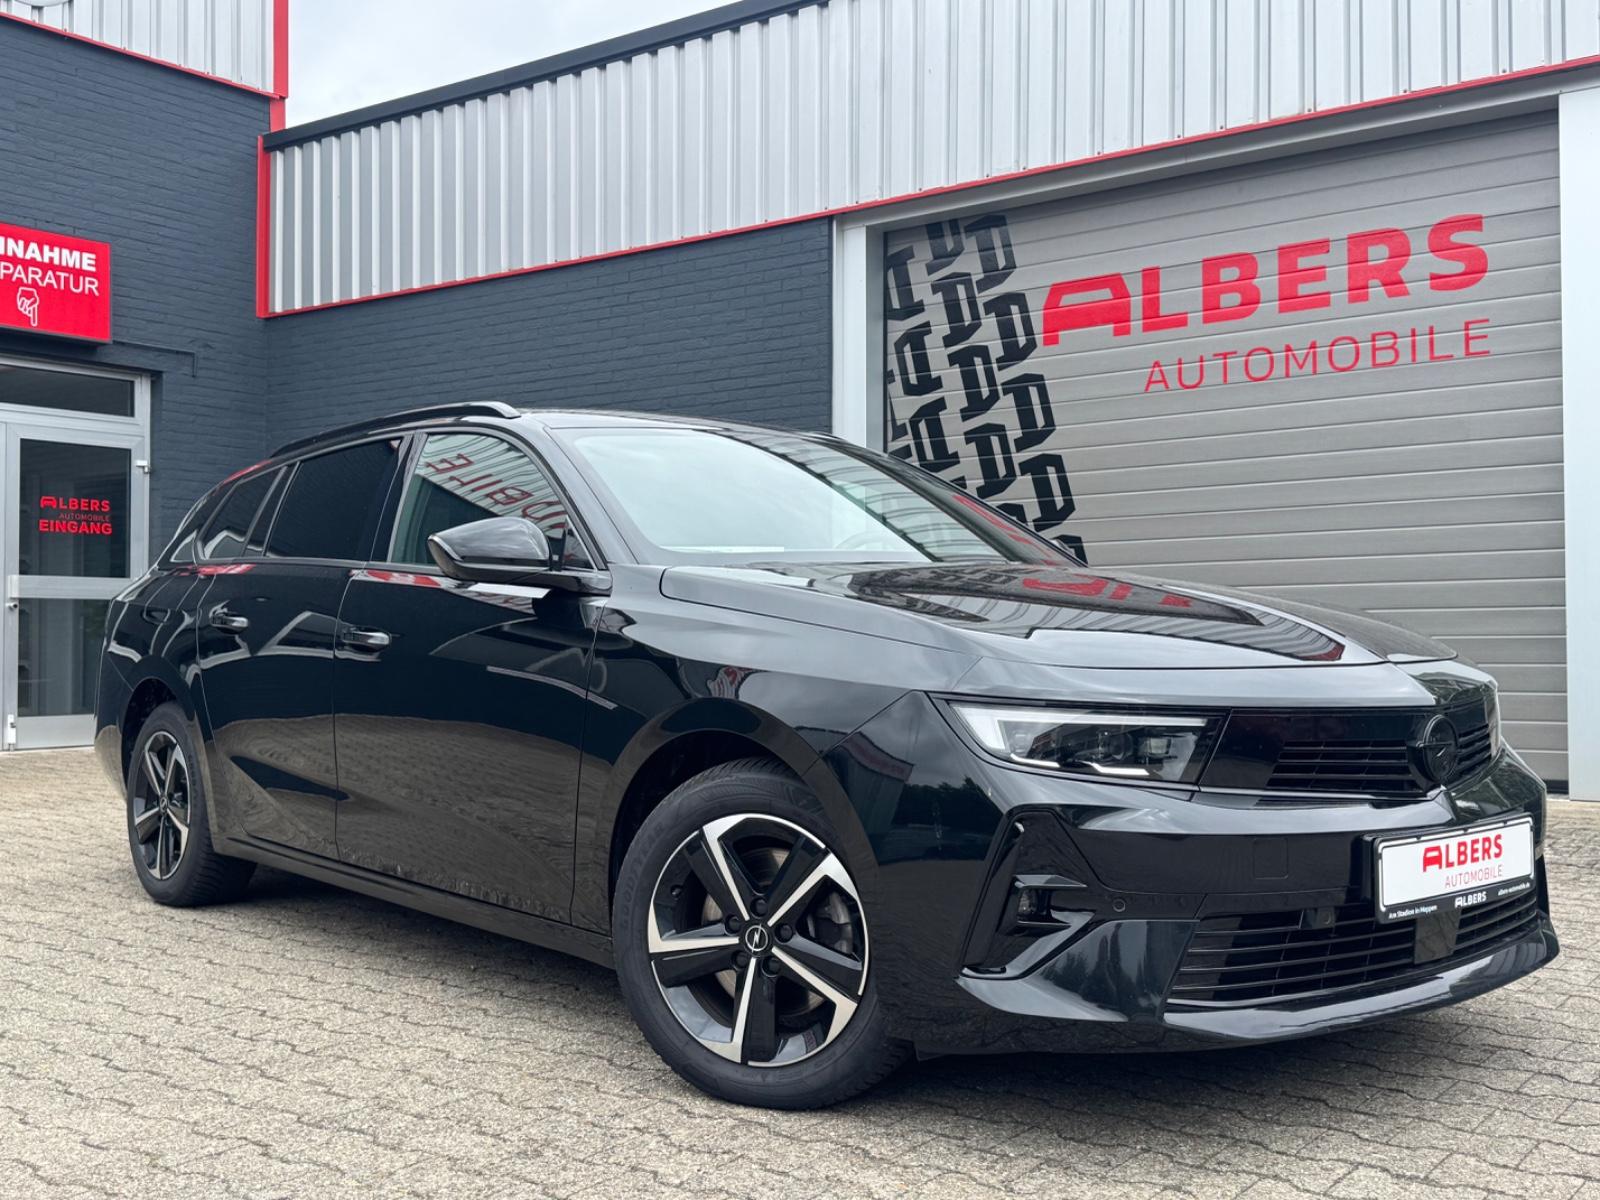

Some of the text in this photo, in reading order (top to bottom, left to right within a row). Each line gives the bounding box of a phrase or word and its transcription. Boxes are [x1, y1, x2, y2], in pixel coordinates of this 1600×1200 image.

[0, 261, 99, 296] PARATUR
[1042, 213, 1489, 347] ALBERS
[1144, 318, 1491, 393] AUTOMOBILE
[40, 495, 110, 512] ALBERS
[39, 519, 112, 536] EINGANG
[58, 512, 111, 523] AUTOMOBILE
[1422, 834, 1503, 873] ALBERS
[1445, 864, 1503, 889] AUTOMOBILE
[1454, 891, 1487, 909] ALBERS
